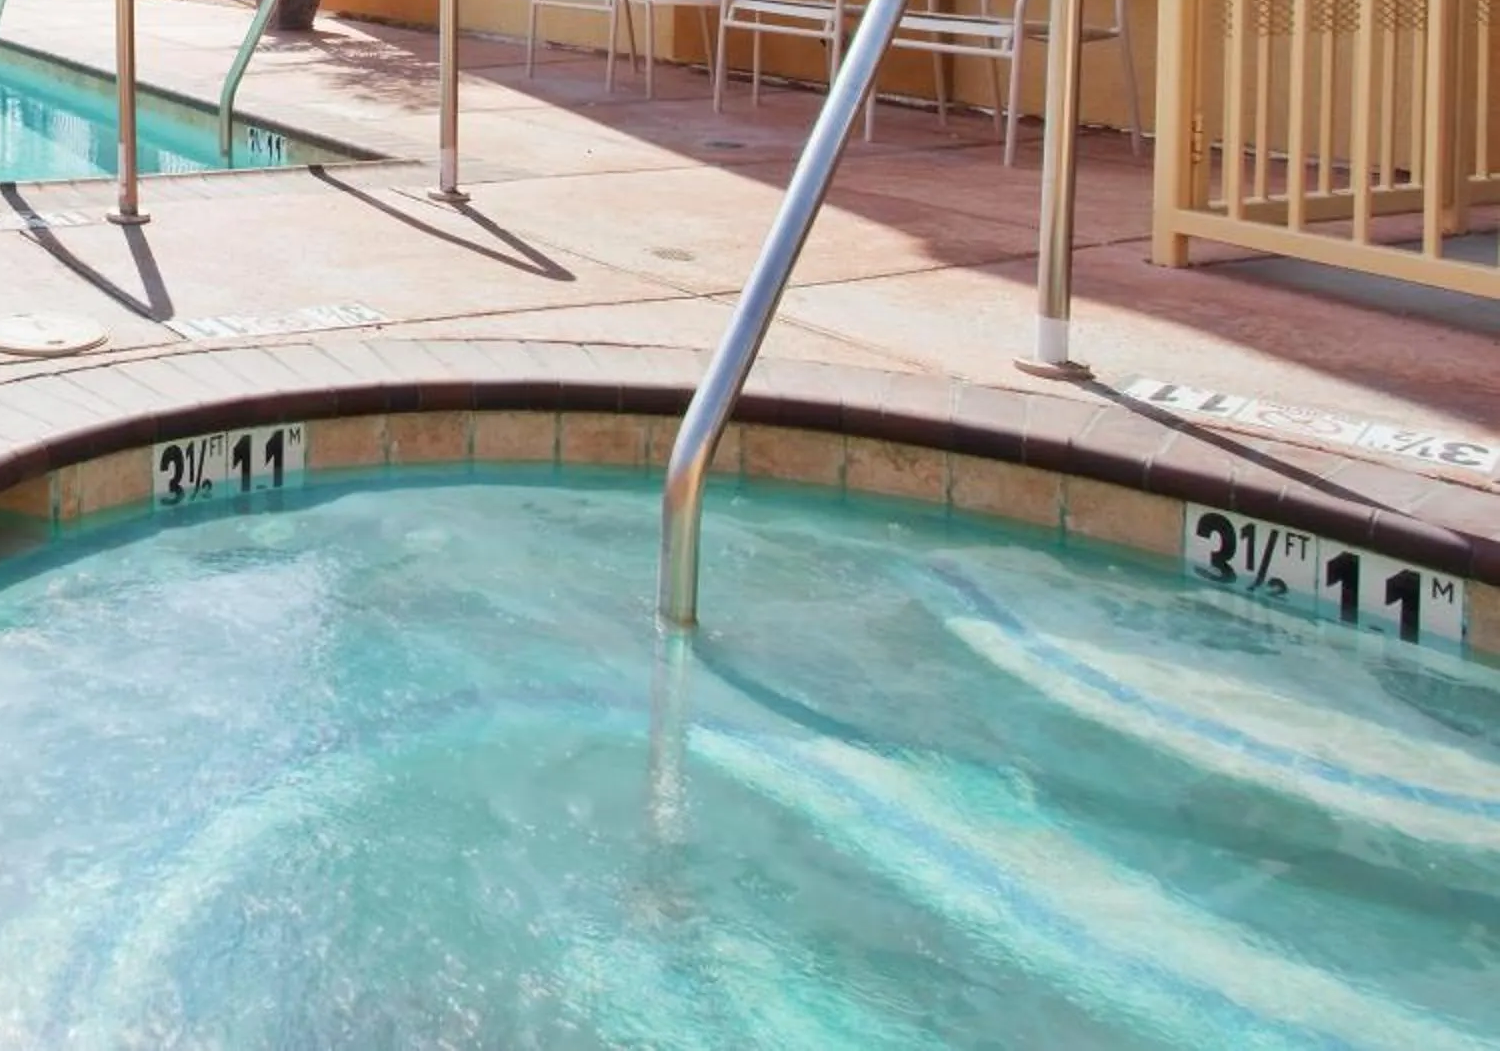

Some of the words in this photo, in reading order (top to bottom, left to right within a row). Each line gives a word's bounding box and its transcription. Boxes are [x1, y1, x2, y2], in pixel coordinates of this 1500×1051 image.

[209, 434, 224, 458] FT
[288, 427, 301, 446] M
[1285, 531, 1312, 562] FT
[1431, 577, 1454, 605] M
